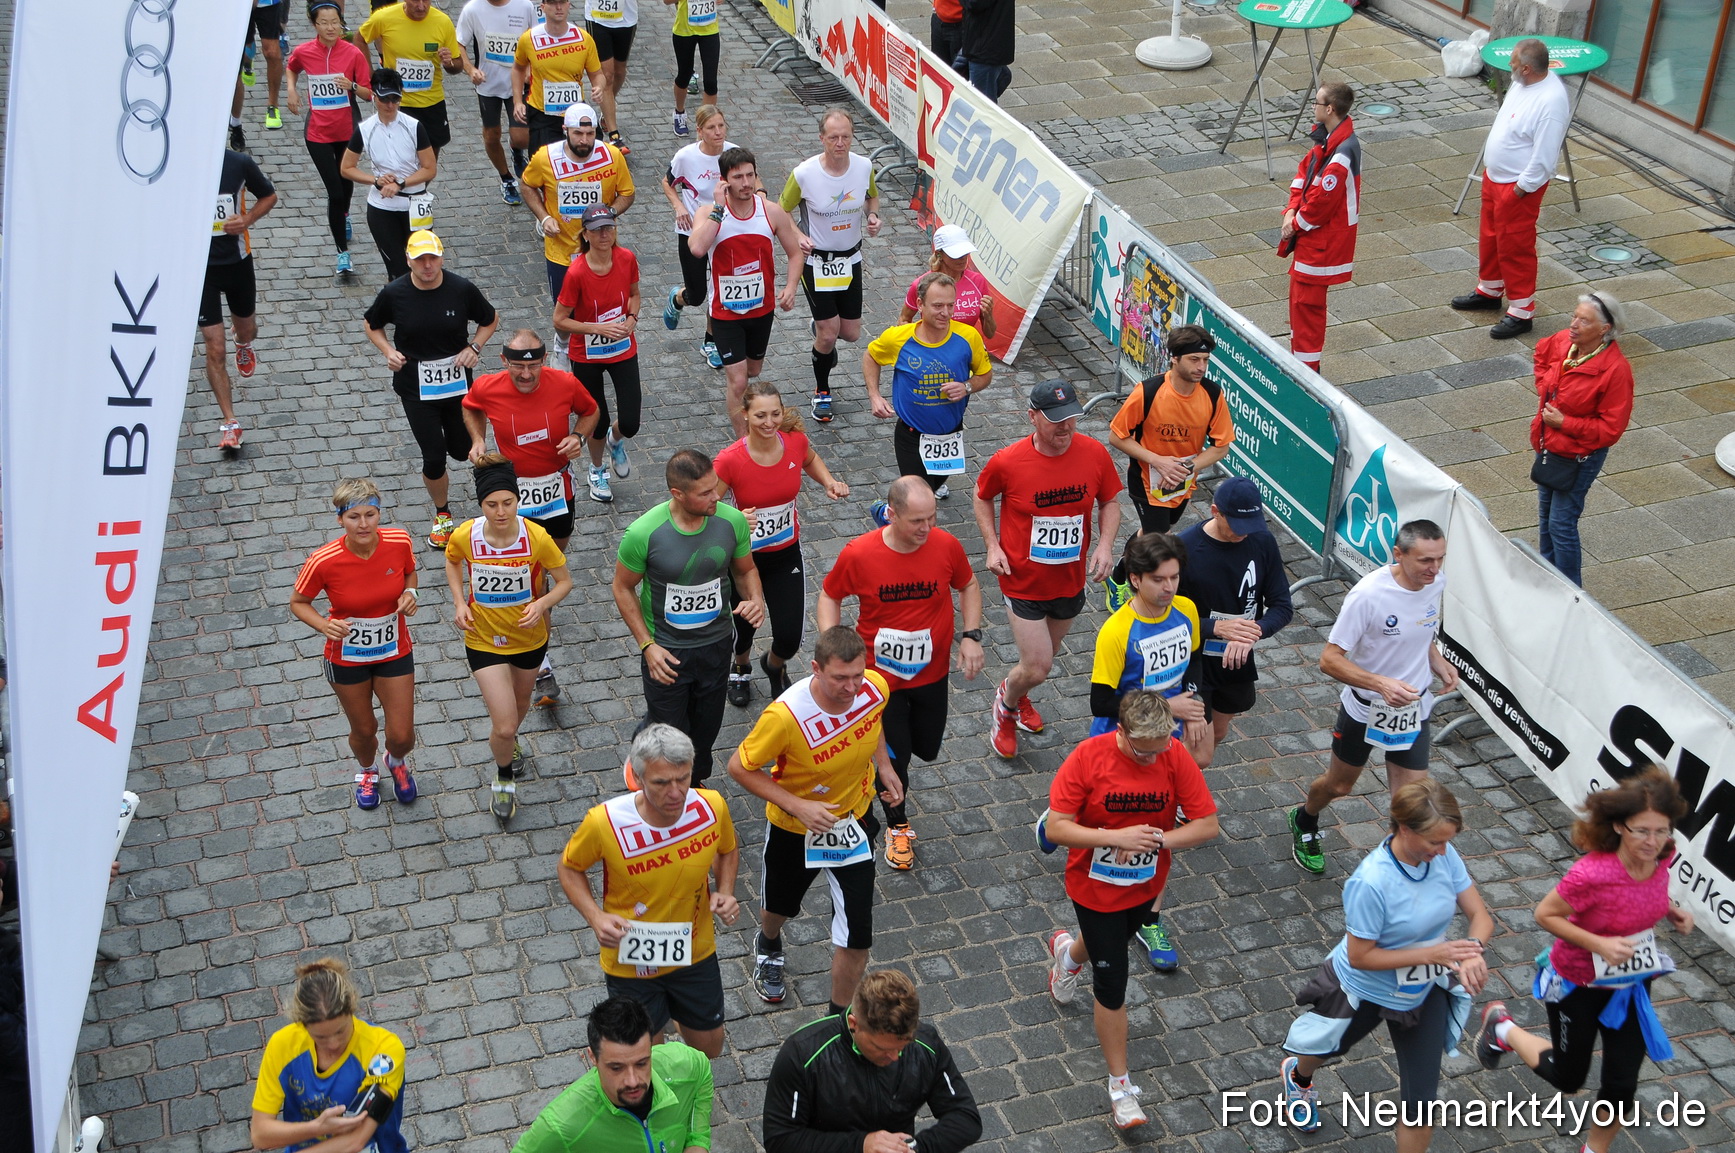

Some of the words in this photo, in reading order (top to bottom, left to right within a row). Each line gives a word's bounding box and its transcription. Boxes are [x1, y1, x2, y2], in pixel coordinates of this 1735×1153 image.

[598, 0, 618, 11] 254
[692, 3, 715, 16] 2733
[488, 41, 517, 54] 3374
[536, 51, 558, 60] MAX
[562, 44, 586, 54] BÖGL
[400, 68, 430, 80] 2282
[548, 90, 578, 102] 2780
[562, 191, 598, 204] 2599
[822, 262, 846, 276] 602
[724, 283, 760, 300] 2217
[102, 270, 160, 476] BKK
[424, 367, 461, 384] 3418
[1221, 380, 1279, 445] Sicherheit
[924, 441, 960, 459] 2933
[520, 483, 560, 506] 2662
[1273, 496, 1293, 522] 6352
[756, 512, 790, 538] 3344
[1037, 527, 1078, 546] 2018
[1046, 550, 1068, 558] Günter
[478, 576, 524, 592] 2221
[671, 592, 716, 612] 3325
[76, 520, 142, 744] Audi
[348, 624, 394, 646] 2518
[880, 642, 926, 662] 2011
[1149, 640, 1188, 672] 2575
[888, 661, 917, 674] Andreas
[1374, 711, 1416, 732] 2464
[1487, 687, 1504, 708] die
[1504, 702, 1554, 759] verbinden
[812, 736, 852, 766] MAX
[812, 824, 860, 848] 2049
[626, 853, 673, 876] MAX
[678, 830, 720, 860] BÖGL
[627, 938, 684, 962] 2318
